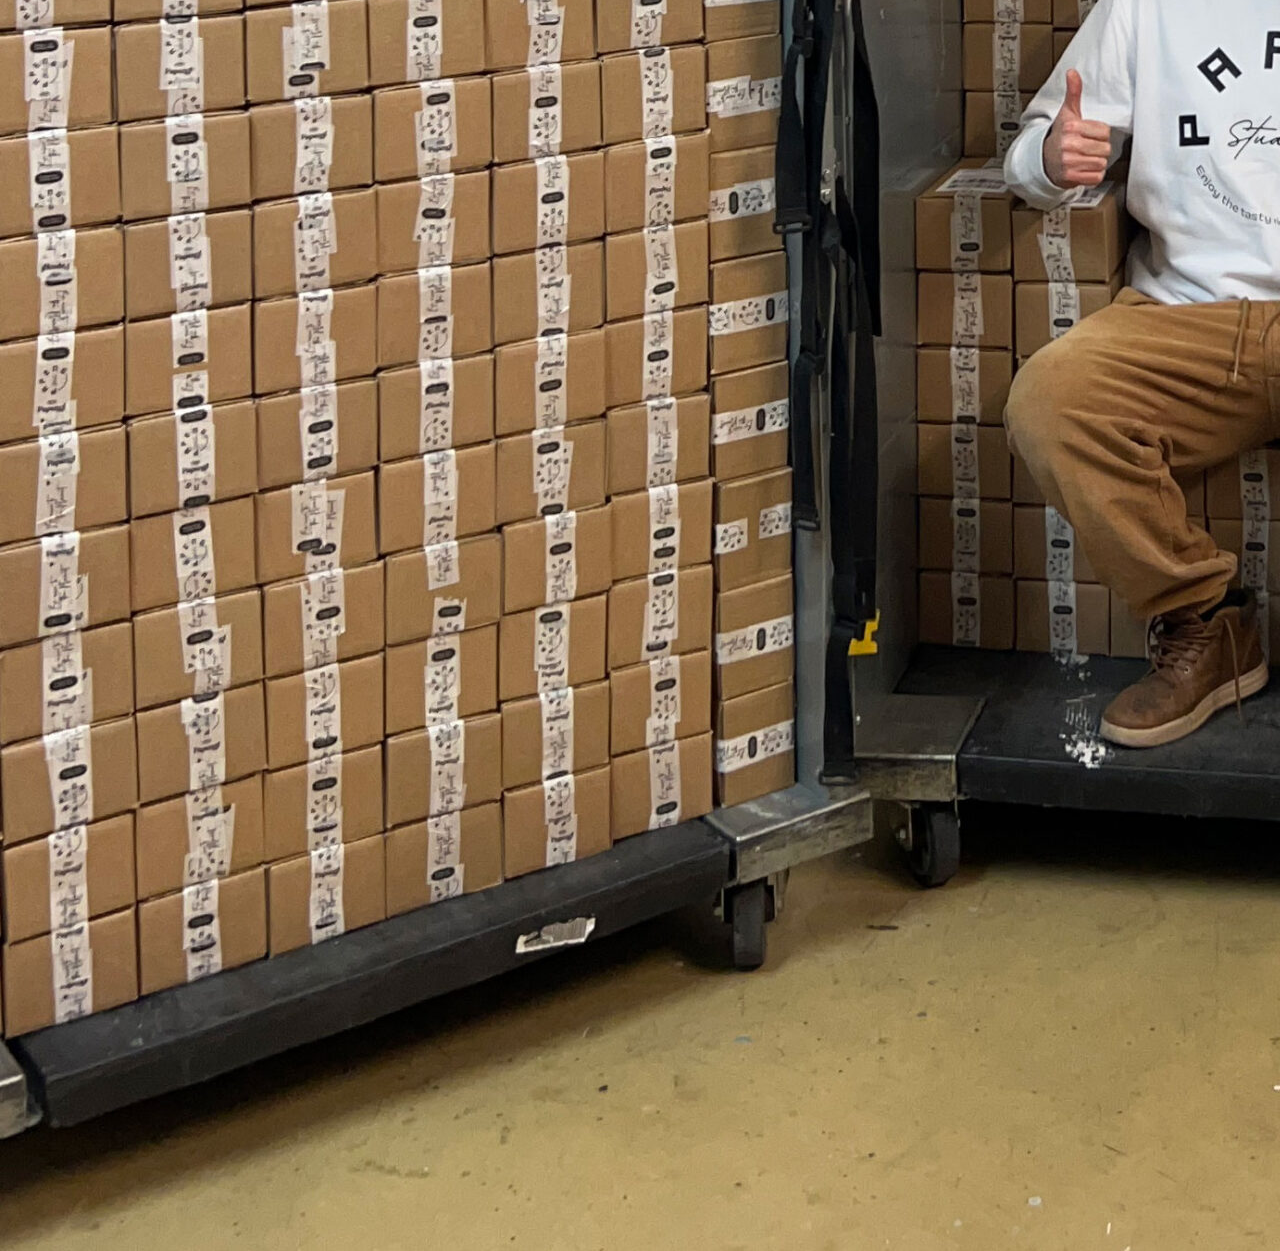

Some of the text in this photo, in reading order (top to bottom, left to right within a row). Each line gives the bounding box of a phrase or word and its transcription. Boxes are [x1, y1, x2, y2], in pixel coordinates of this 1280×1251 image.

[1195, 164, 1221, 200] Enjoy
[1221, 194, 1239, 213] the
[1240, 209, 1273, 226] tasty
